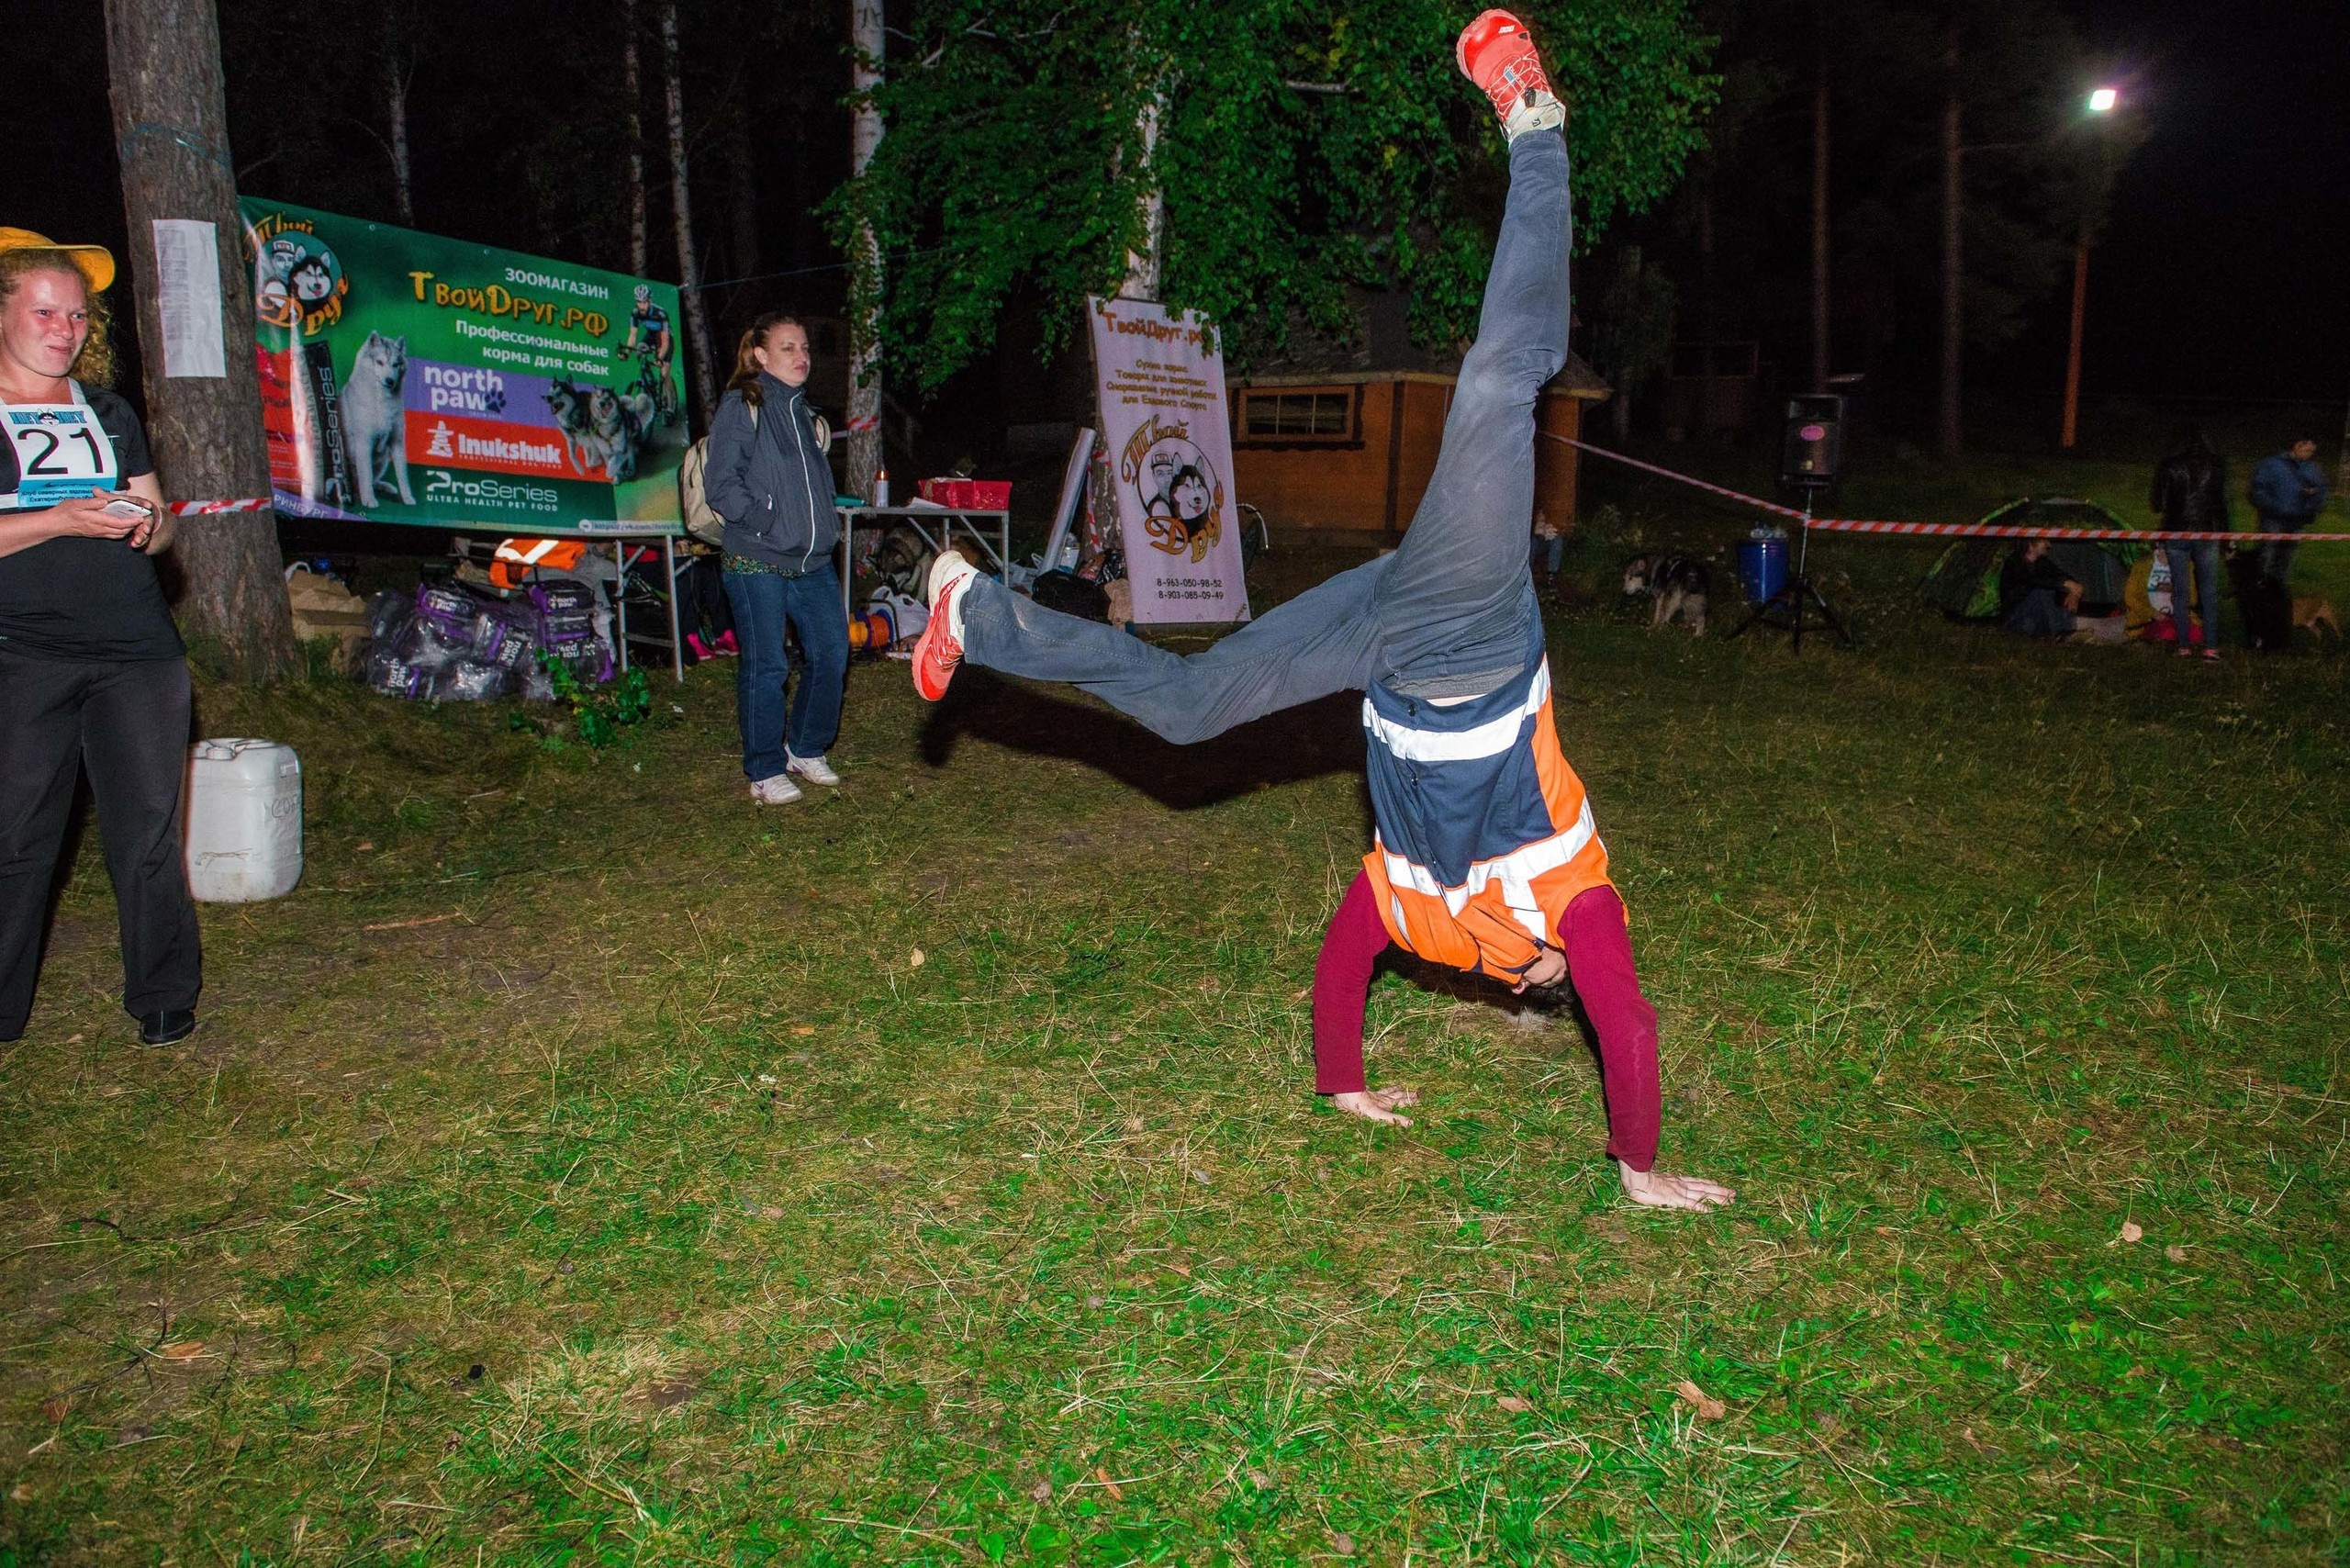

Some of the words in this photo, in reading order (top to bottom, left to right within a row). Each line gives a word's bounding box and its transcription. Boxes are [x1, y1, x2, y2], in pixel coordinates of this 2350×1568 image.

[505, 267, 609, 300] ЗООМАГАЗИН
[455, 319, 609, 358] Профессиональные
[483, 346, 530, 364] корма
[534, 355, 562, 369] для
[566, 358, 610, 376] собак
[424, 365, 503, 392] north
[431, 386, 487, 411] paw
[17, 428, 104, 476] 21
[458, 433, 562, 465] Inukshuk
[426, 470, 558, 503] ProSeries
[426, 494, 460, 504] ULTRA
[464, 497, 503, 508] HEALTH
[508, 501, 526, 510] PET
[531, 503, 558, 511] FOOD
[1156, 577, 1223, 588] 8-963-050-98-52
[1158, 590, 1225, 600] 8-903-085-09-49
